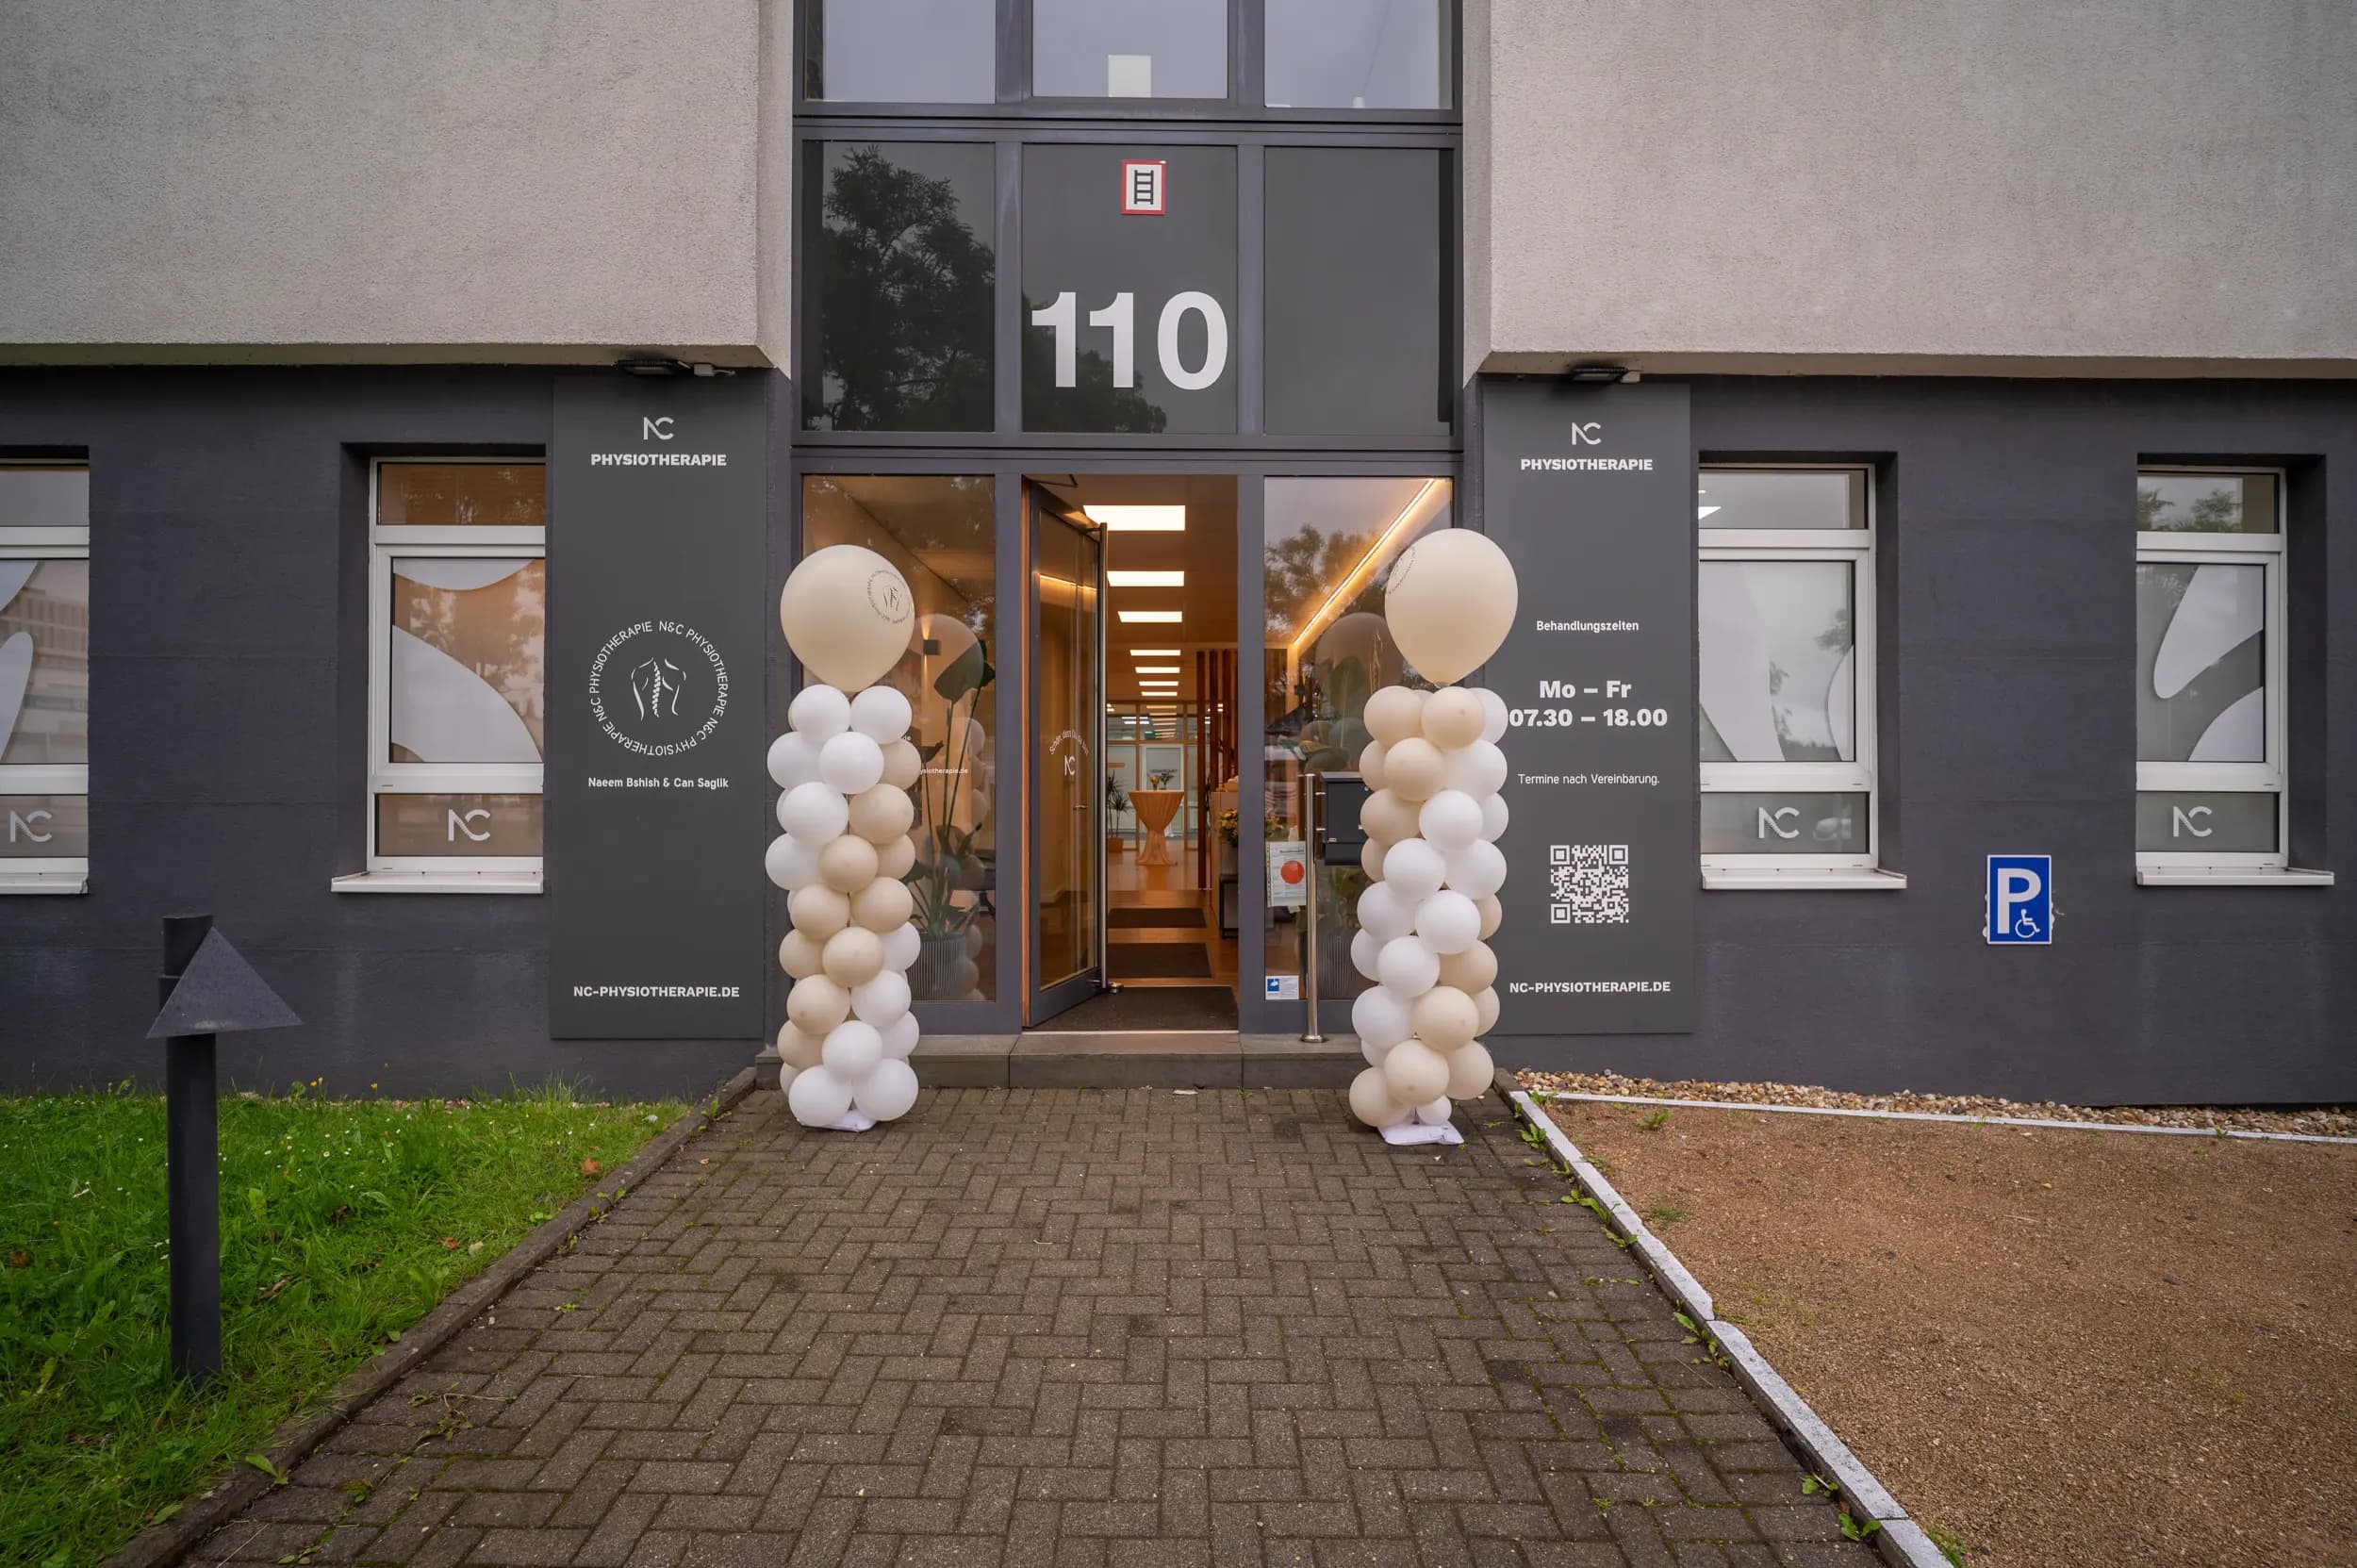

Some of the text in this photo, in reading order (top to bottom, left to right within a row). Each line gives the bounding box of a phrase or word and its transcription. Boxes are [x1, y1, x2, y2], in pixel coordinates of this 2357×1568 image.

[1031, 290, 1228, 390] 110
[643, 416, 675, 440] NC
[1571, 421, 1602, 446] NC
[590, 453, 727, 467] PHYSIOTHERAPIE
[1520, 458, 1653, 471] PHYSIOTHERAPIE
[658, 619, 684, 635] N&C
[1536, 619, 1640, 634] Behandlungszeiten
[588, 620, 653, 694] PHYSIOTHERAPIE
[685, 628, 729, 718] PHYSIOTHERAPIE
[1539, 680, 1576, 699] Mo
[1606, 680, 1632, 699] Fr
[1508, 708, 1574, 727] 07.30
[1603, 708, 1668, 727] 18.00
[602, 720, 698, 756] PHYSIOTHERAPIE
[587, 777, 623, 788] Naeem
[626, 777, 660, 788] Bshish
[663, 778, 670, 788] &
[673, 778, 694, 788] Can
[1517, 773, 1660, 786] Termine nach Vereinbarung.
[448, 808, 492, 842] NC
[1757, 806, 1801, 839] NC
[2172, 805, 2213, 837] NC
[1996, 867, 2042, 935] P
[573, 985, 740, 998] NC-PHYSIOTHERAPIE.DE
[1509, 981, 1672, 994] NC-PHYSIOTHERAPIE.DE
